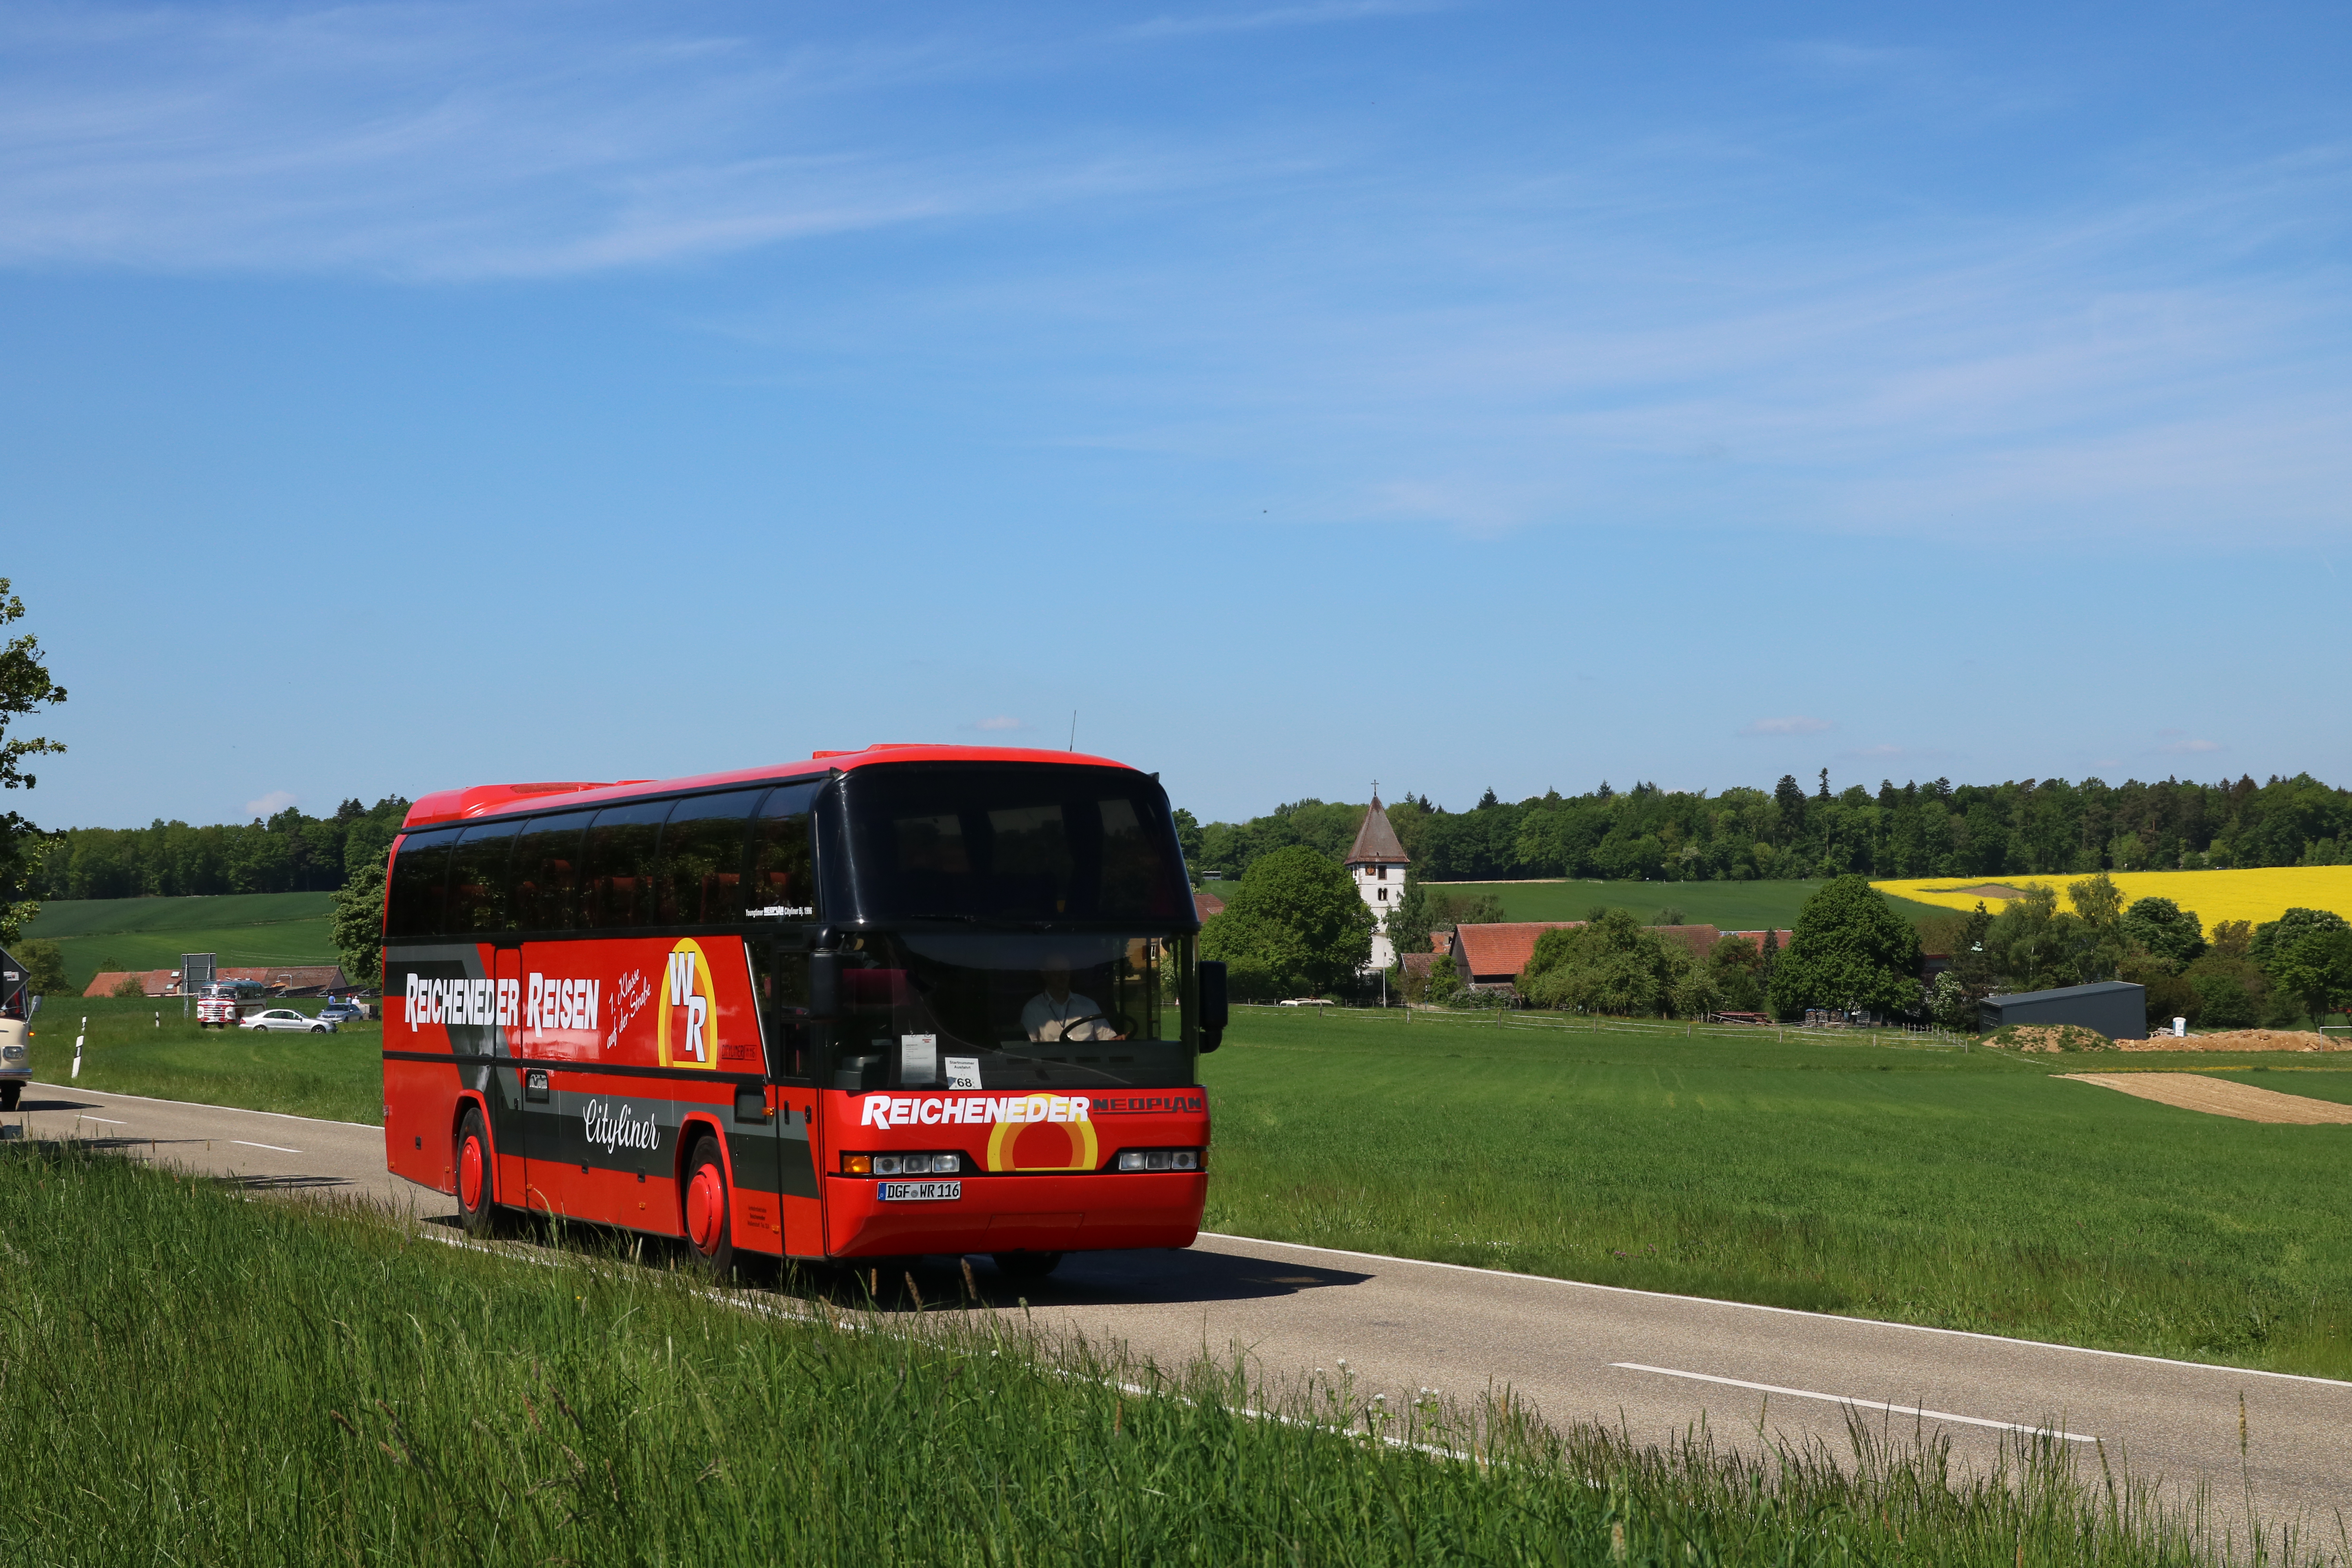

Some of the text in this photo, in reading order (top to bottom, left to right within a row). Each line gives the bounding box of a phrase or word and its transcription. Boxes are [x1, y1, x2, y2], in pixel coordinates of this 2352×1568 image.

[746, 909, 763, 918] Youngtimer
[764, 906, 784, 916] NEOPLAN
[784, 907, 799, 916] Cityliner
[405, 973, 600, 1038] REICHENEDER REISEN
[609, 969, 640, 1015] 1. Klasse
[607, 976, 651, 1049] auf der Straße
[957, 1078, 972, 1087] 68
[861, 1095, 1090, 1129] REICHENEDER
[1093, 1096, 1201, 1114] NEOPLAN
[583, 1099, 660, 1154] Cityliner
[887, 1184, 959, 1198] DGF WR 116
